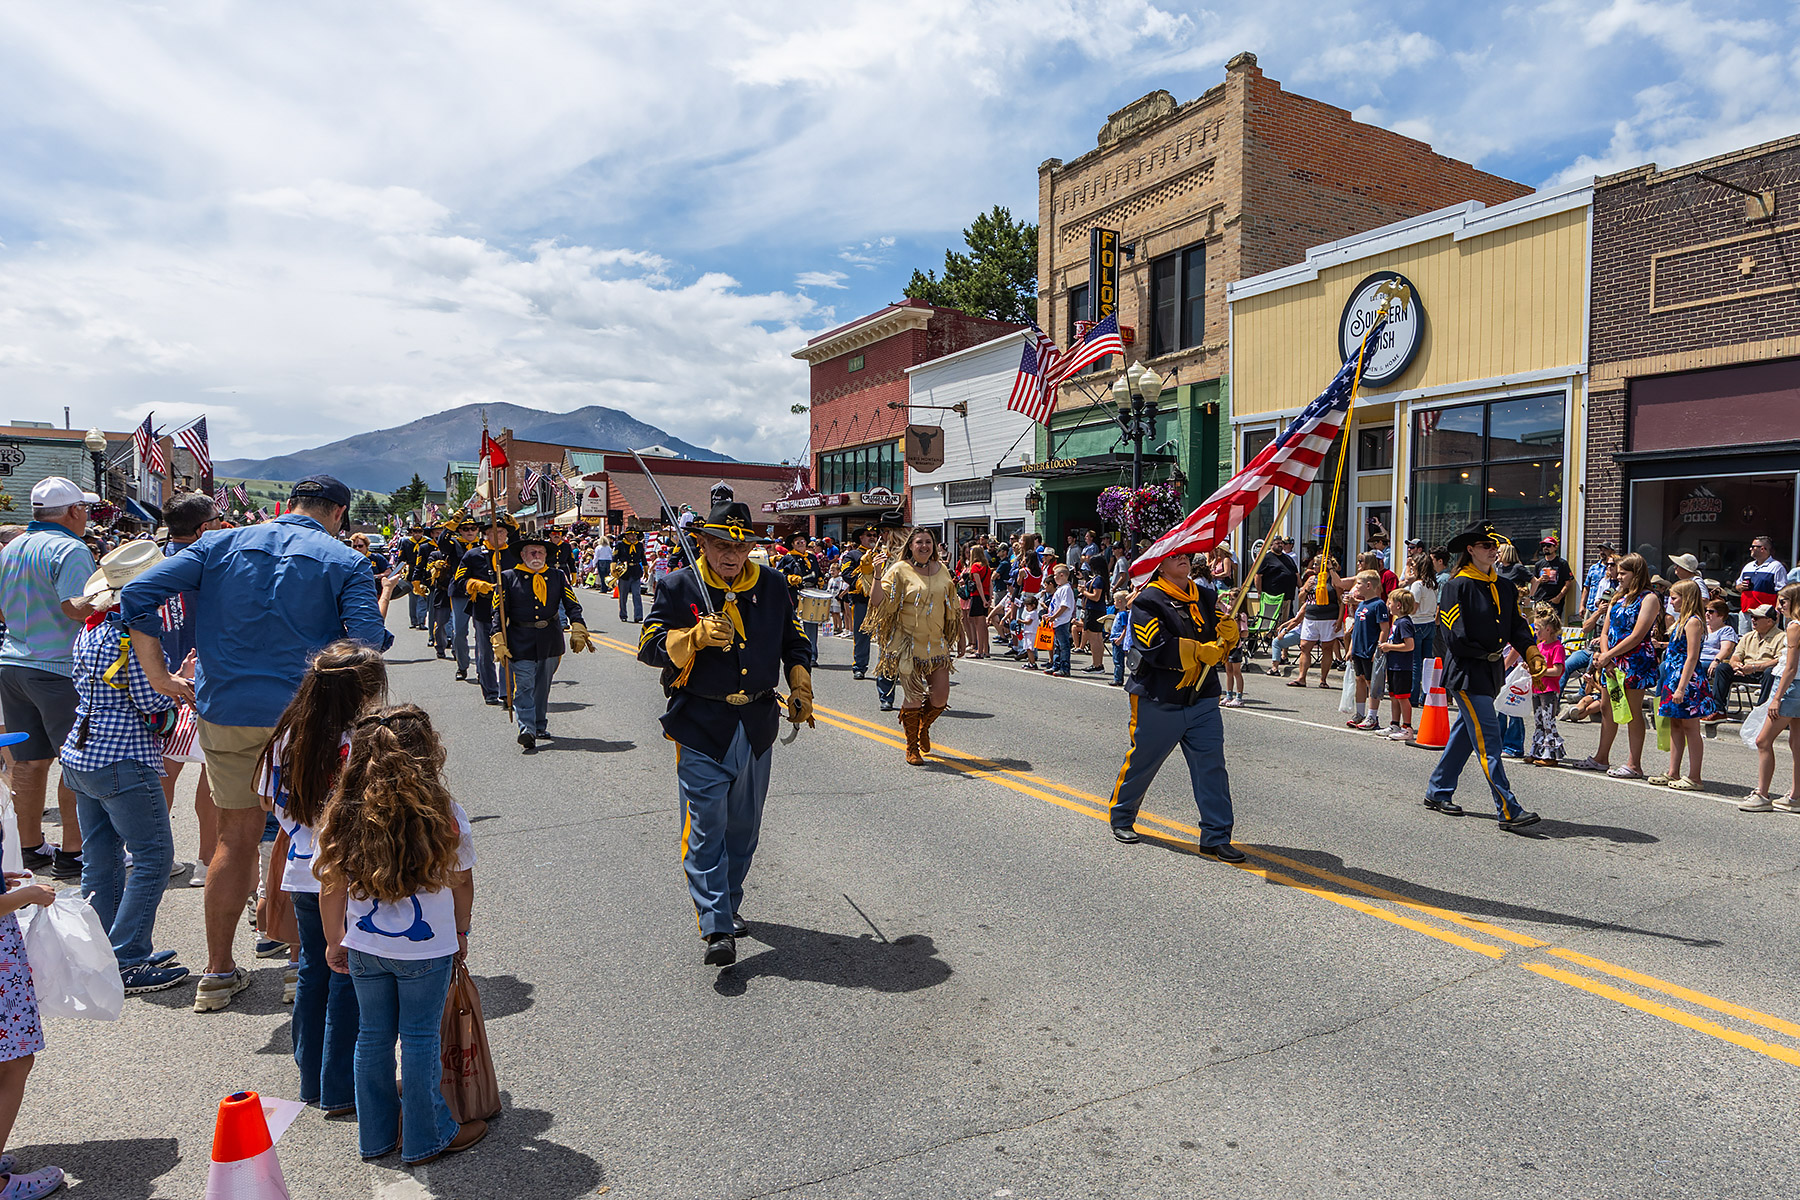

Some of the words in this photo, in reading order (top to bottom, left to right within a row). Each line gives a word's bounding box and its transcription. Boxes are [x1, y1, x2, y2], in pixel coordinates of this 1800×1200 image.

[1350, 305, 1408, 337] SOUERN
[1379, 331, 1395, 351] ISH
[1384, 354, 1400, 368] HOME
[0, 454, 21, 462] KS
[1022, 462, 1046, 472] FOSTER
